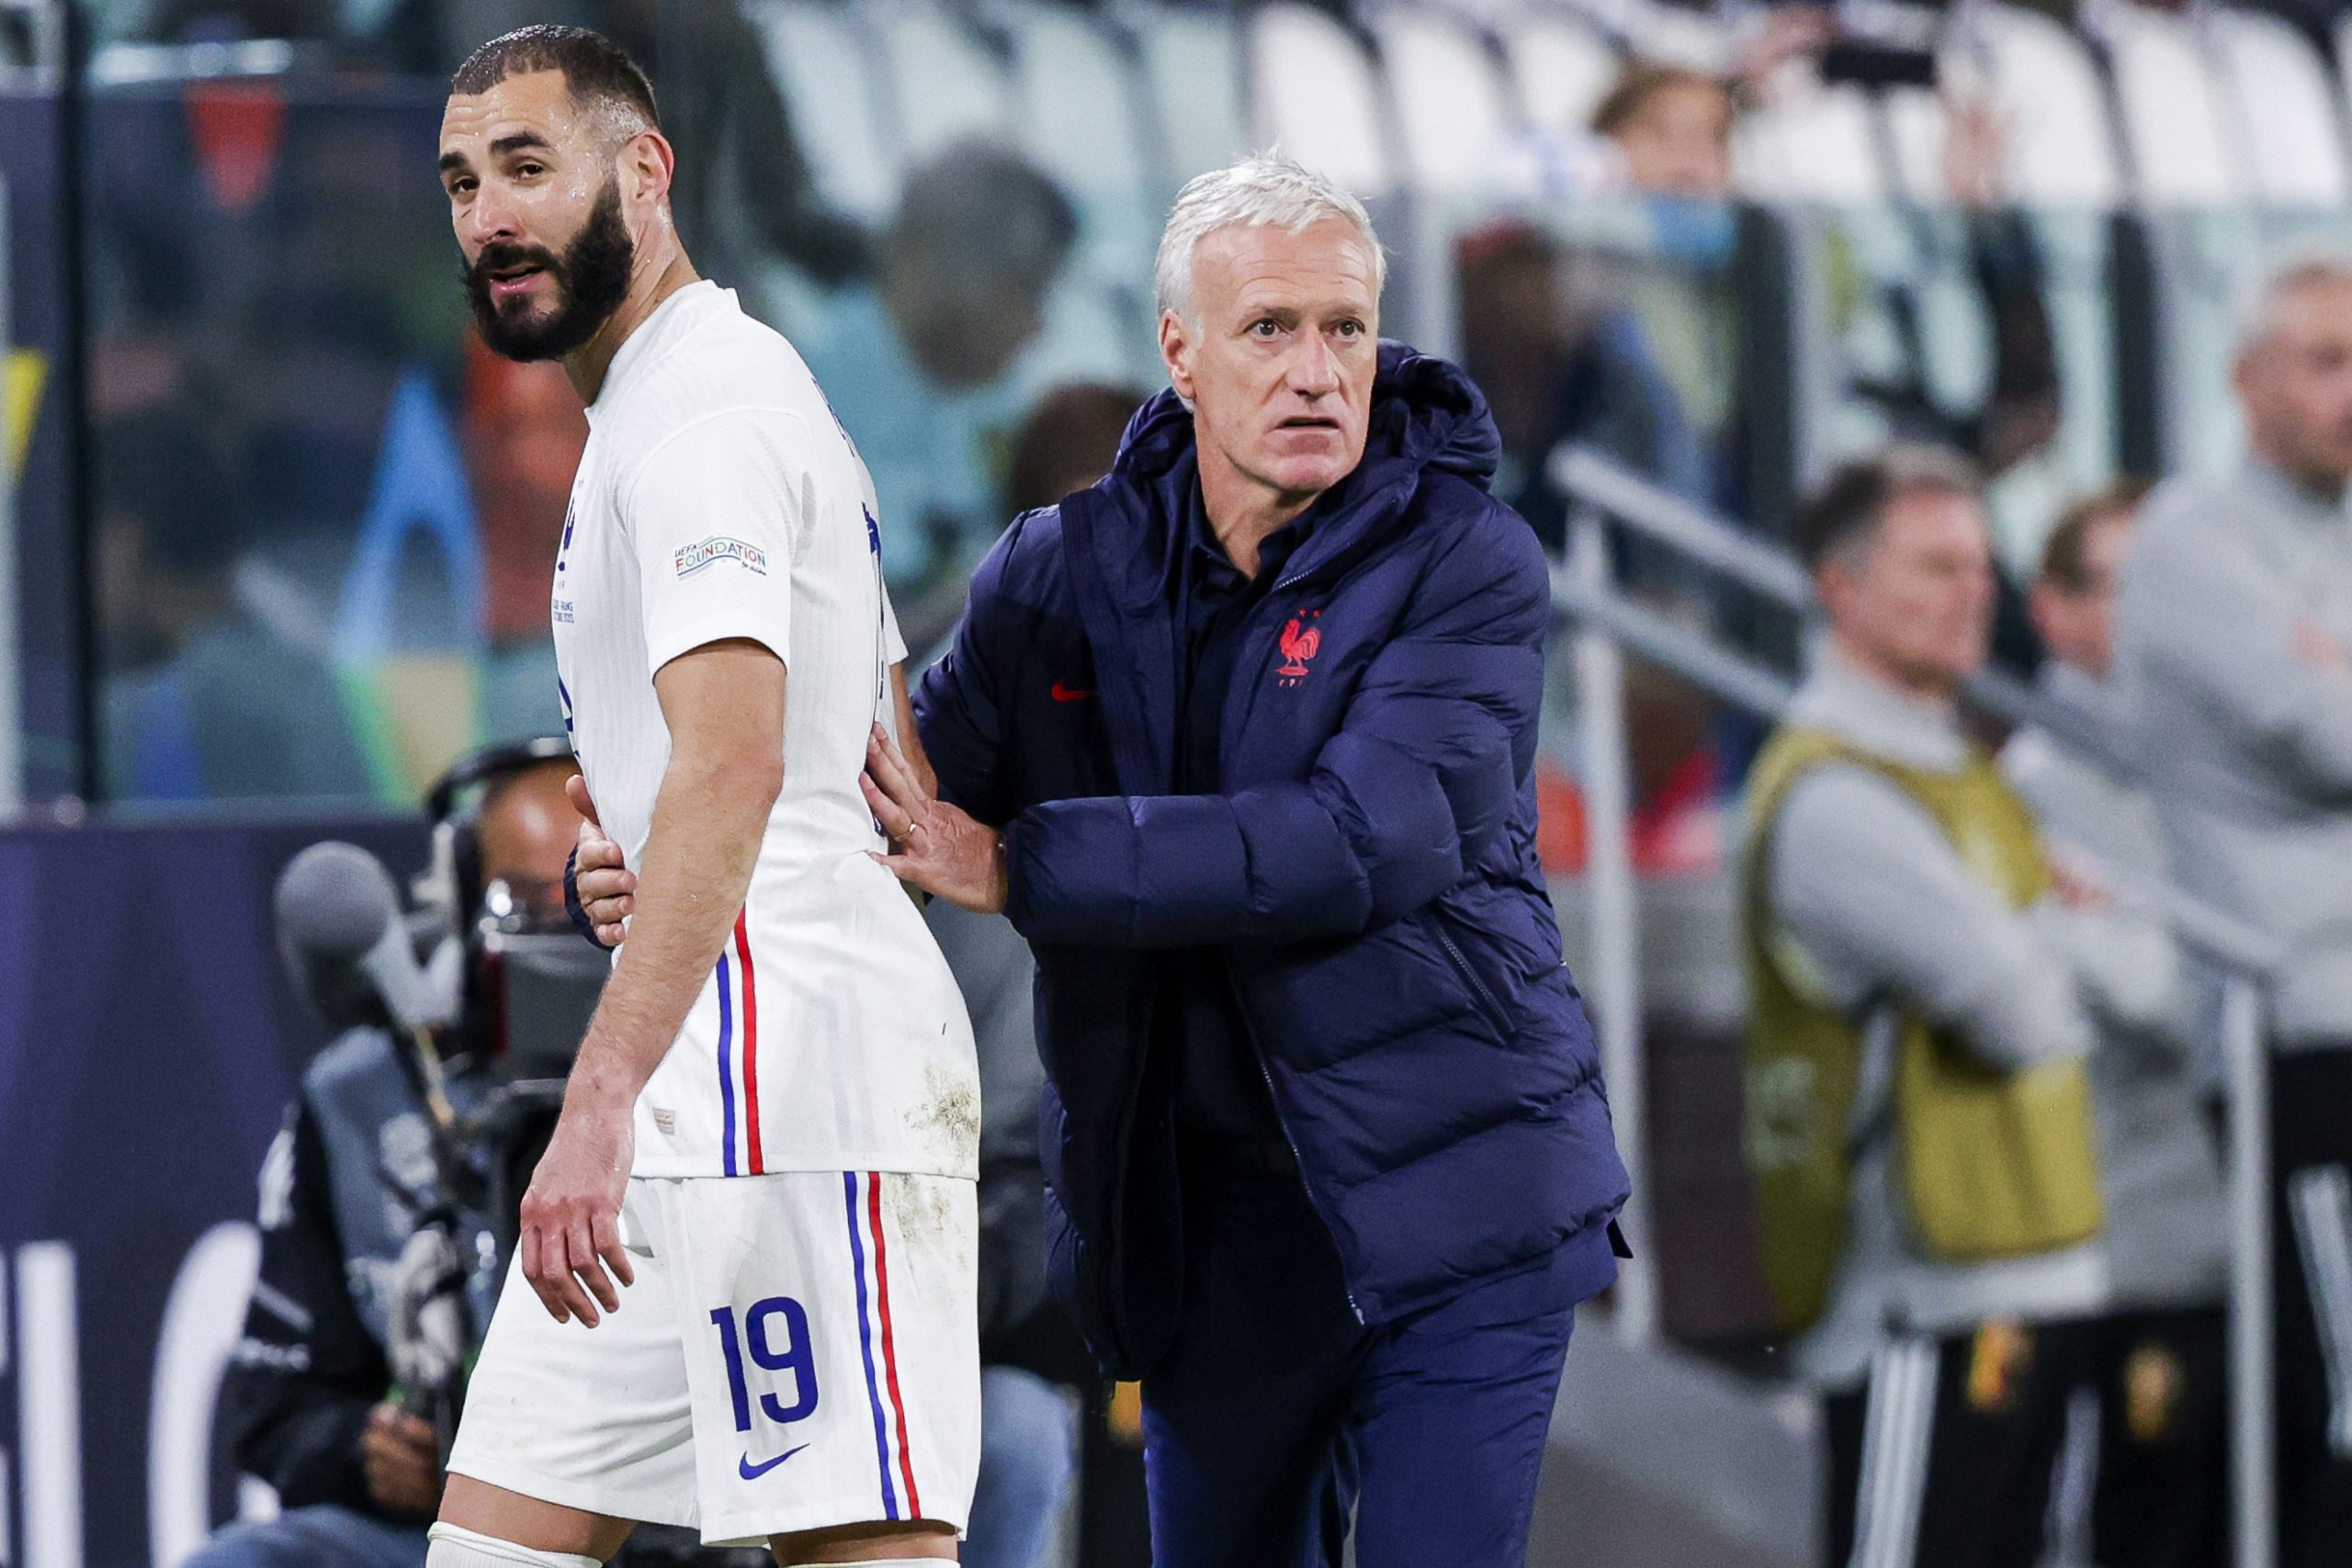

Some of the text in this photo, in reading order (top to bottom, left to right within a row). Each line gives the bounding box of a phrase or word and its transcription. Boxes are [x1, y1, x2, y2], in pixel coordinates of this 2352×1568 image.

[674, 544, 697, 558] UEFA
[675, 542, 766, 571] FOUNDATION
[709, 1296, 819, 1432] 19
